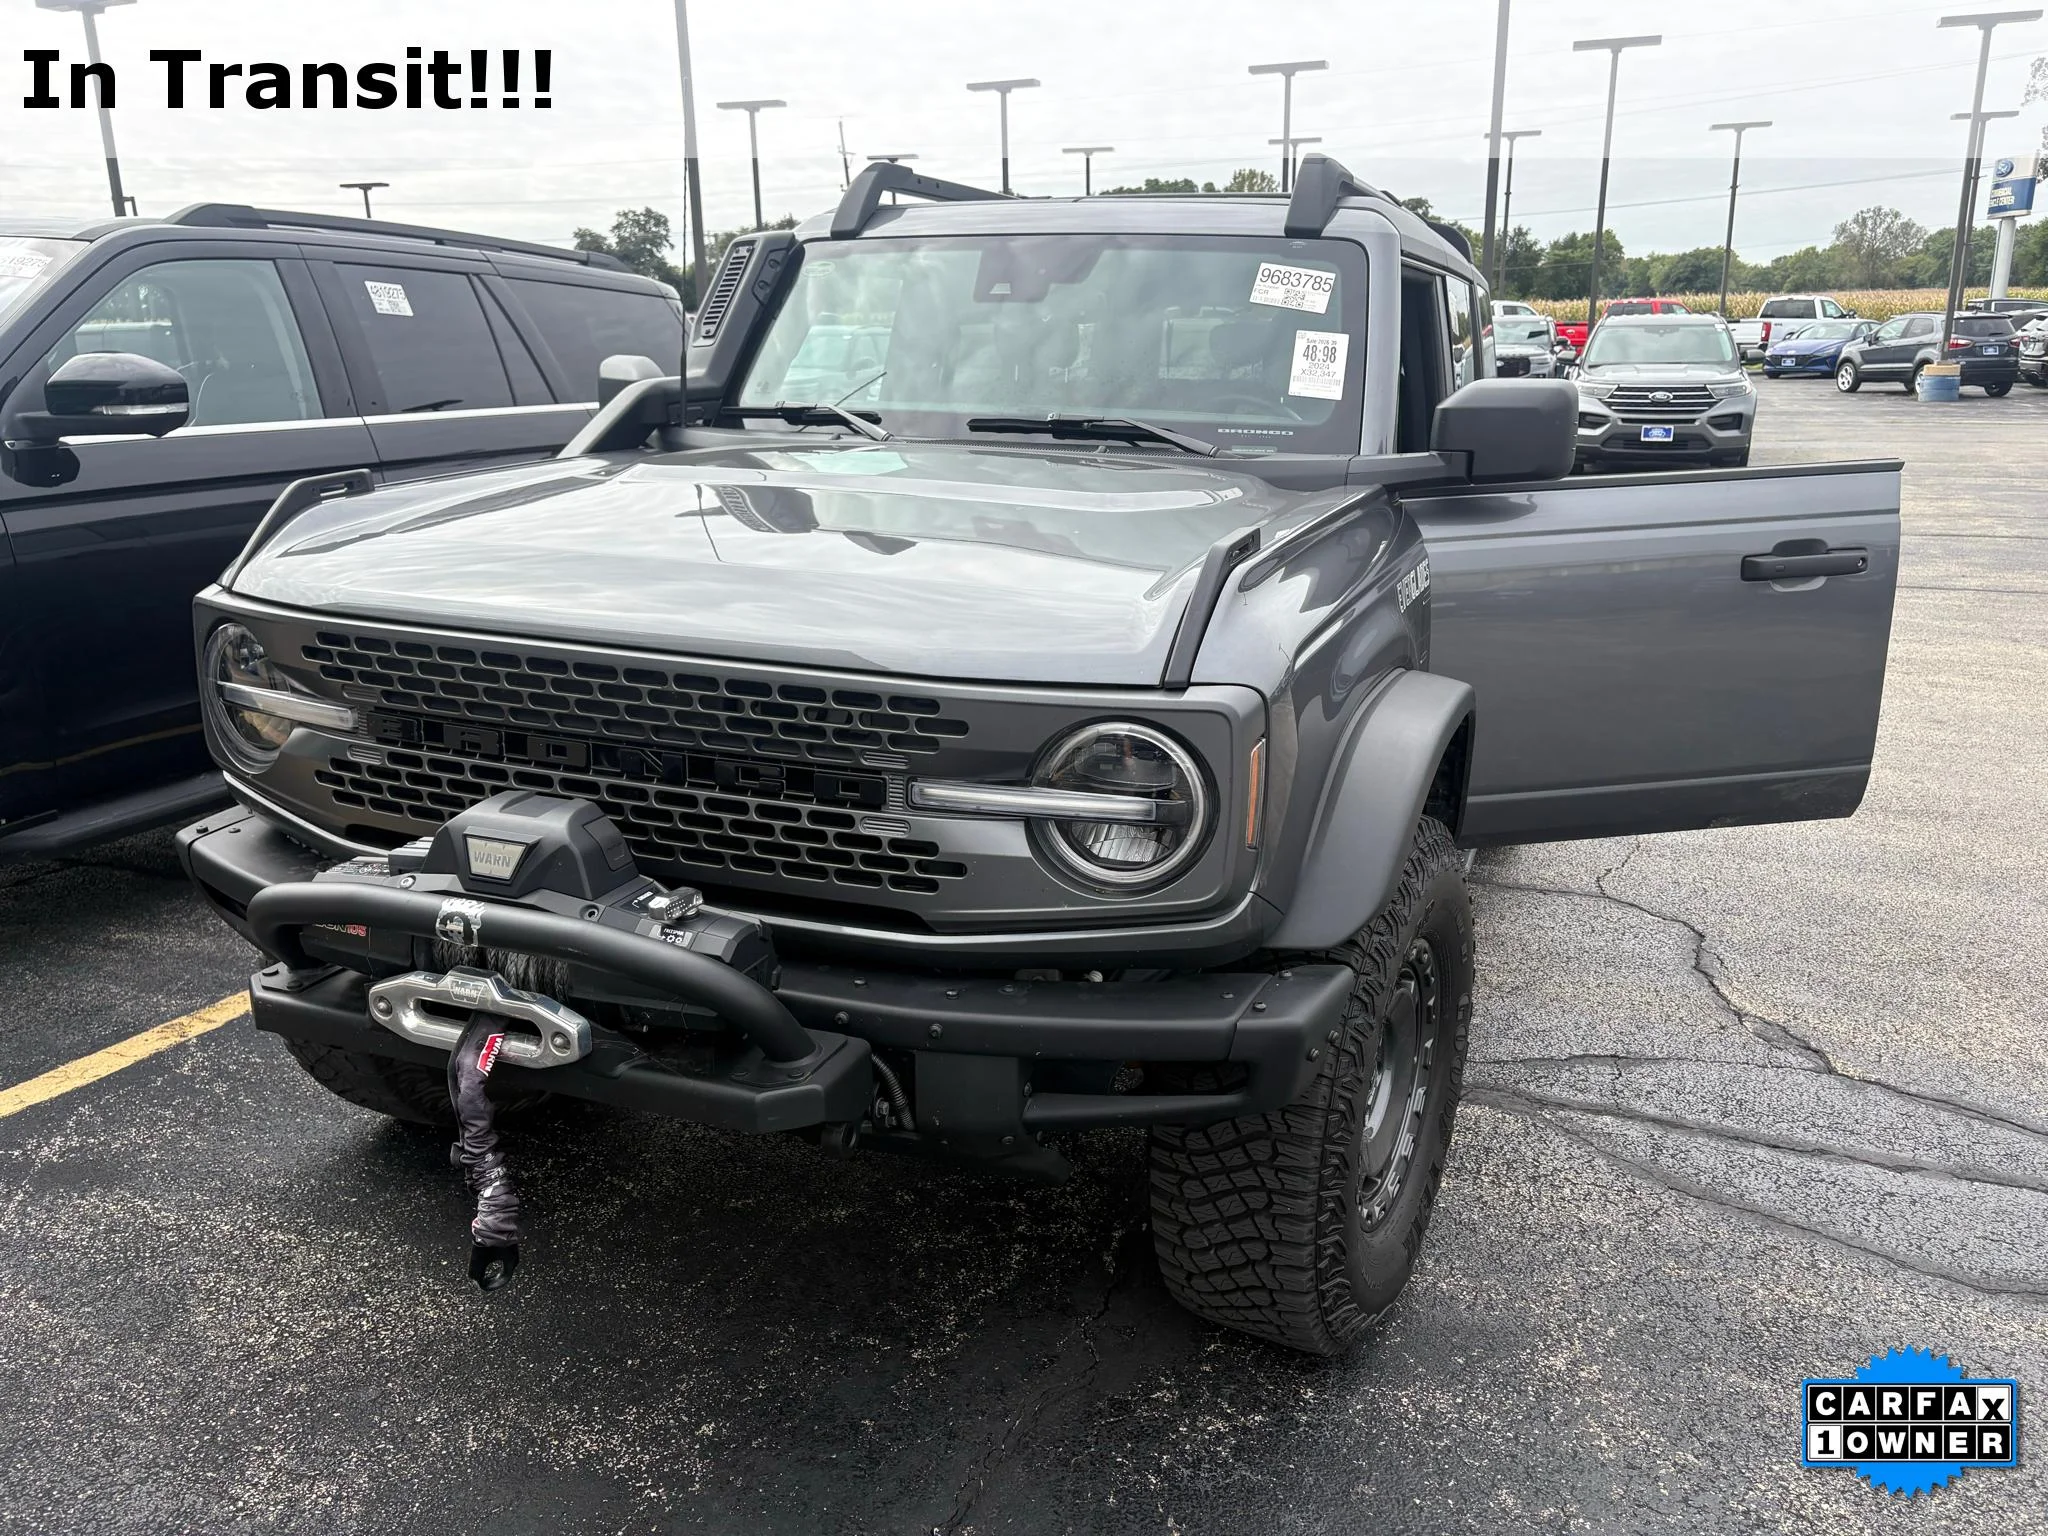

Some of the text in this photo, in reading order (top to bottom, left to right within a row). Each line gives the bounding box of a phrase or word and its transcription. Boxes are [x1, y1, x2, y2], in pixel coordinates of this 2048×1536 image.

[1259, 267, 1334, 293] 9683785
[1302, 344, 1337, 364] 48:98
[1300, 368, 1337, 378] X32,347
[1308, 361, 1331, 370] 2024
[368, 712, 887, 812] BRONCO
[474, 850, 512, 868] WARN
[452, 982, 480, 998] WARN
[484, 1037, 504, 1072] WARN
